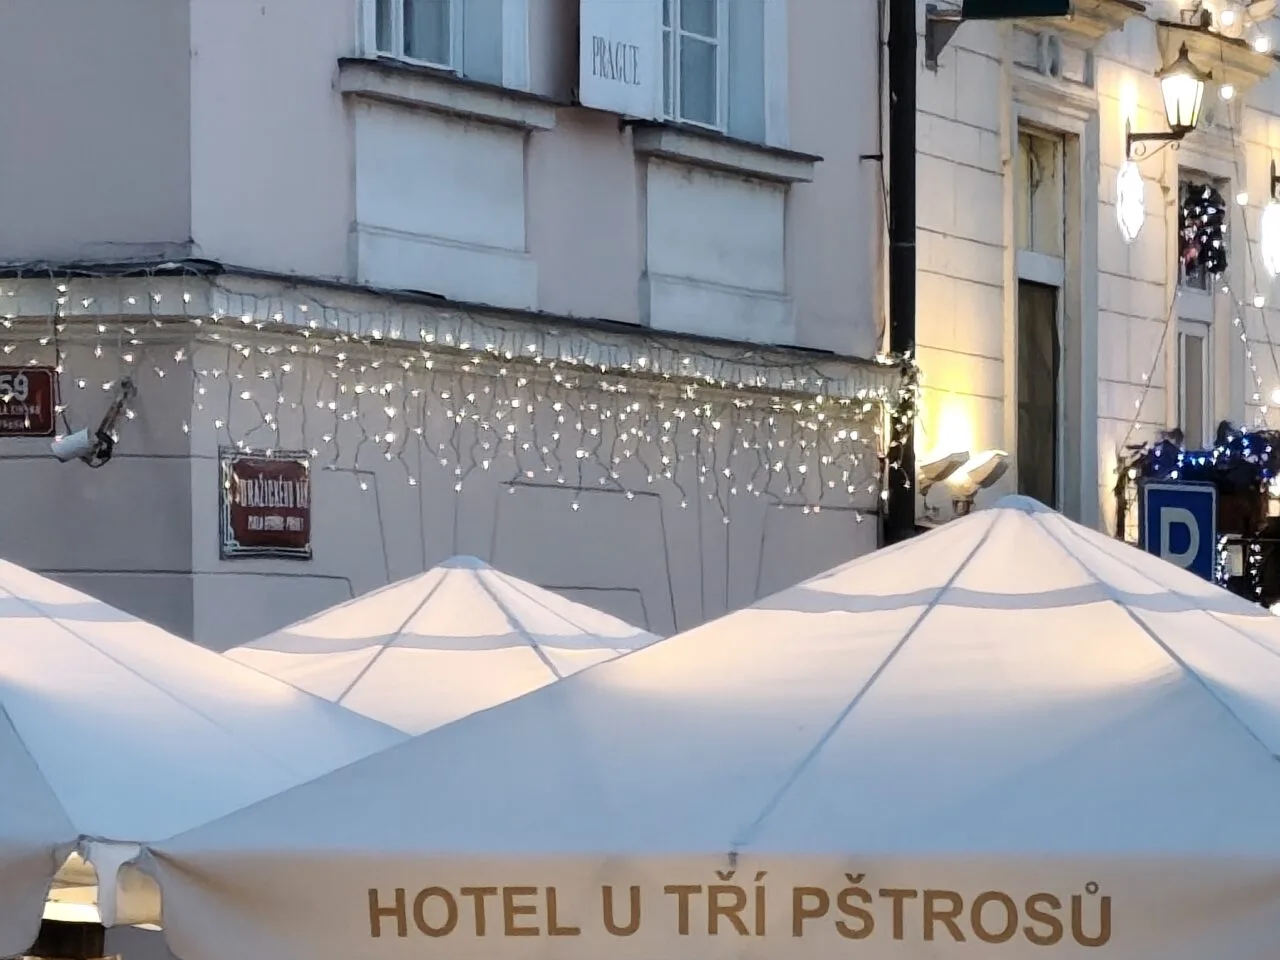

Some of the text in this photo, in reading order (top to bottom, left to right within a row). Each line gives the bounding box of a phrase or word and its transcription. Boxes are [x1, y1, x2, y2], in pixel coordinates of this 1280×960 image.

[592, 35, 641, 86] PRAGUE
[367, 870, 1112, 948] HOTEL U TŘÍ PŠTROSŮ
